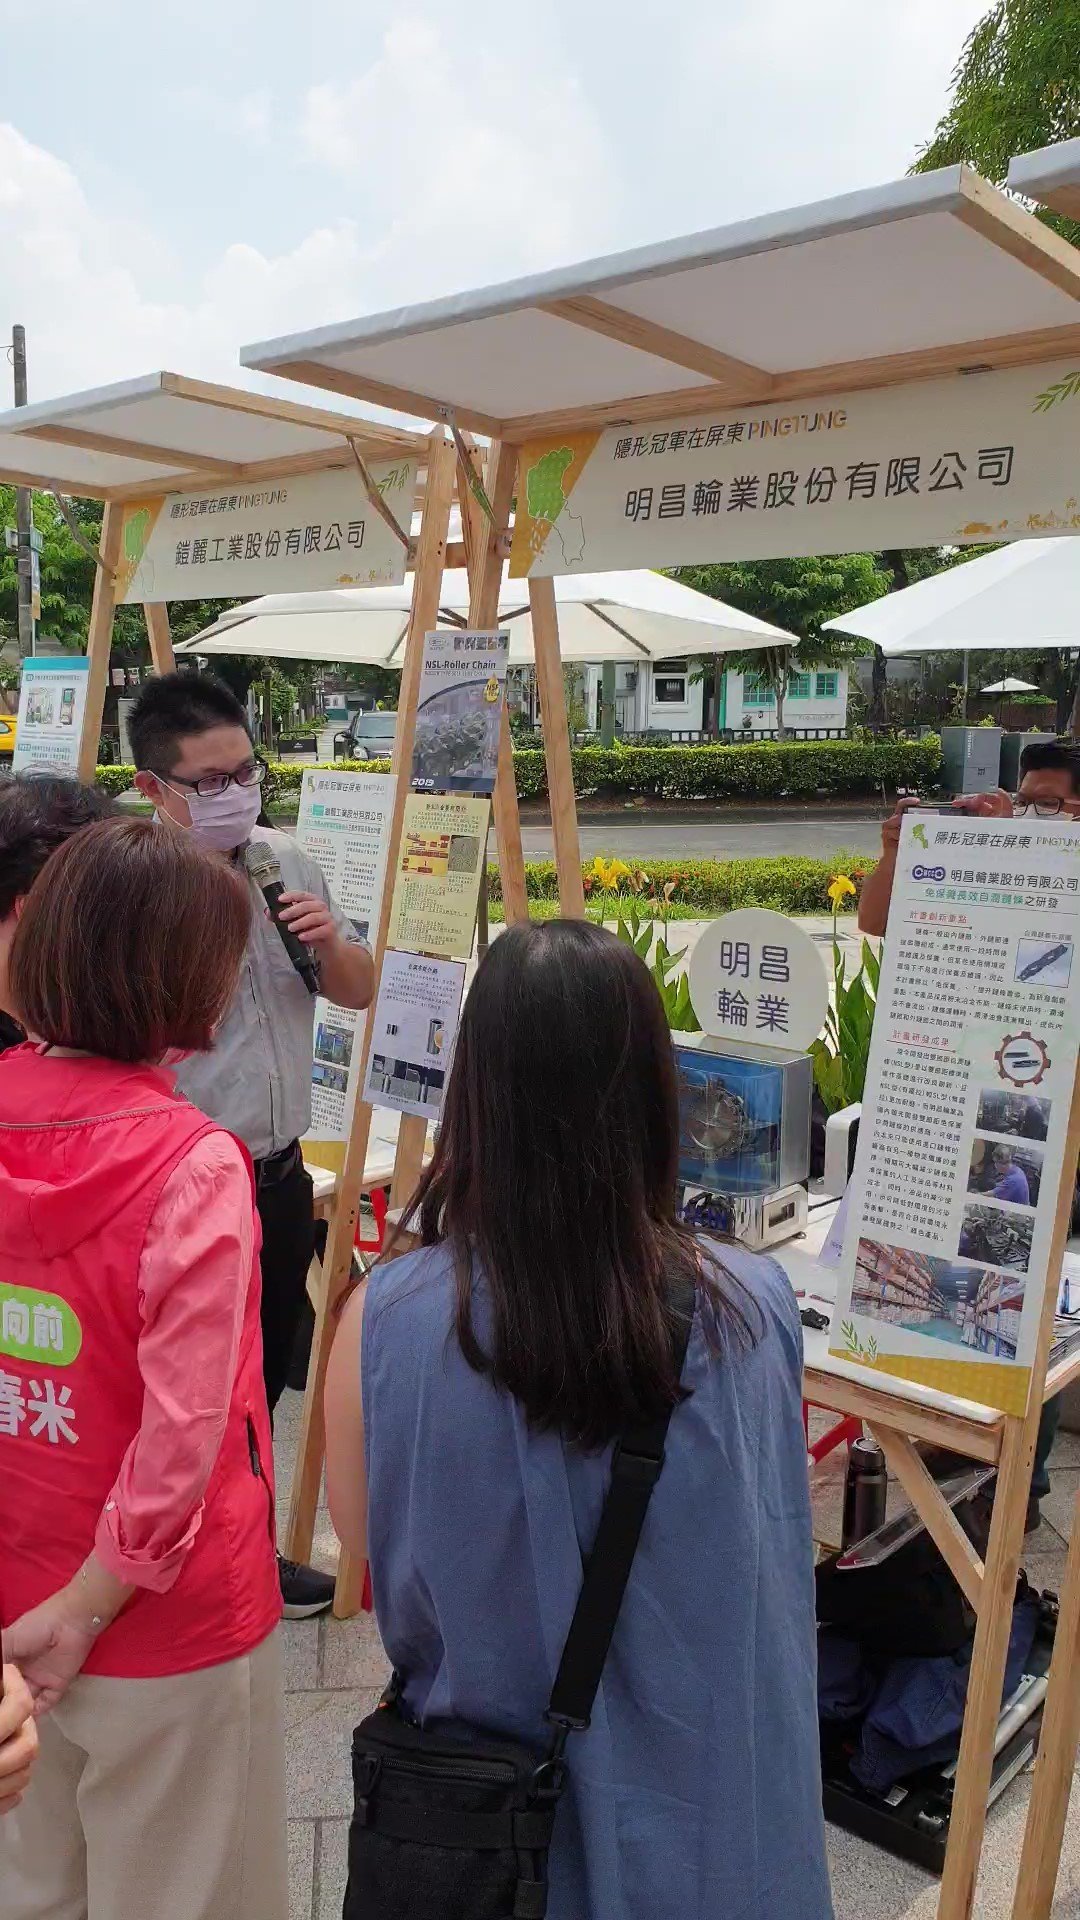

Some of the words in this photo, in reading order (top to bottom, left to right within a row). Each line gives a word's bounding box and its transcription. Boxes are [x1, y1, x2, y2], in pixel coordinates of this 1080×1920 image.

[614, 422, 746, 460] 隱形冠軍在屏東
[748, 409, 847, 440] PINGTUNG
[624, 446, 1016, 523] 明昌輪業股份有限公司
[170, 496, 238, 518] 隱形冠軍在屏東
[239, 489, 288, 508] PINGTUNG
[174, 520, 365, 567] 鎧麗工業股份有限公司
[425, 660, 470, 669] NSL-Roller
[472, 660, 496, 669] Chain
[411, 778, 434, 786] 2019
[934, 831, 1032, 849] 隱形冠軍在屏東
[925, 887, 1059, 908] 免保養長效自潤鏈條之研發
[950, 869, 1079, 891] 明昌輪業股份有限公司
[719, 940, 790, 983] 明昌
[717, 988, 790, 1034] 輪業
[2, 1297, 64, 1351] 向前
